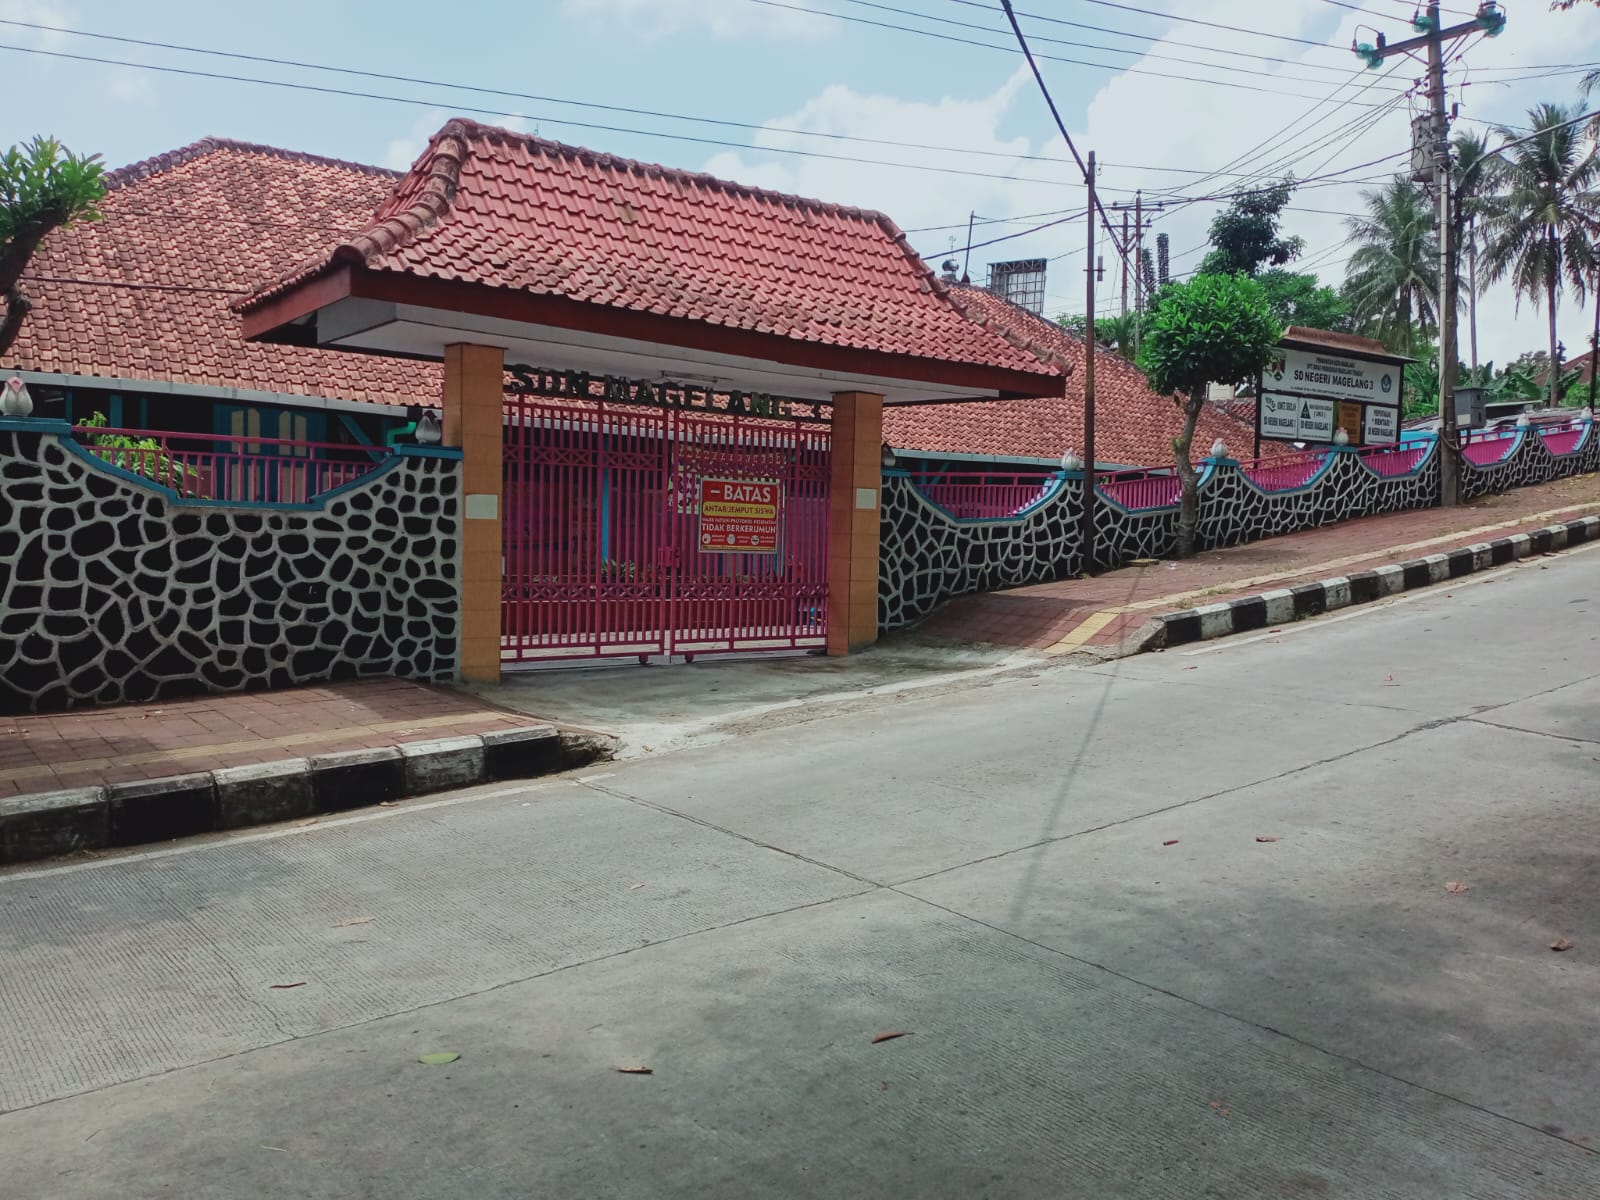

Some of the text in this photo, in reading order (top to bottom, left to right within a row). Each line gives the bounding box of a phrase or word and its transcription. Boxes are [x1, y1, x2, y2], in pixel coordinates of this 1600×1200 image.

[1294, 369, 1304, 381] SD
[1304, 371, 1331, 385] NEGERI
[1332, 374, 1369, 390] MAGELANG
[724, 484, 771, 503] BATAS
[704, 504, 727, 513] ANTAR
[702, 523, 776, 533] TIDAK BERKERUMUN
